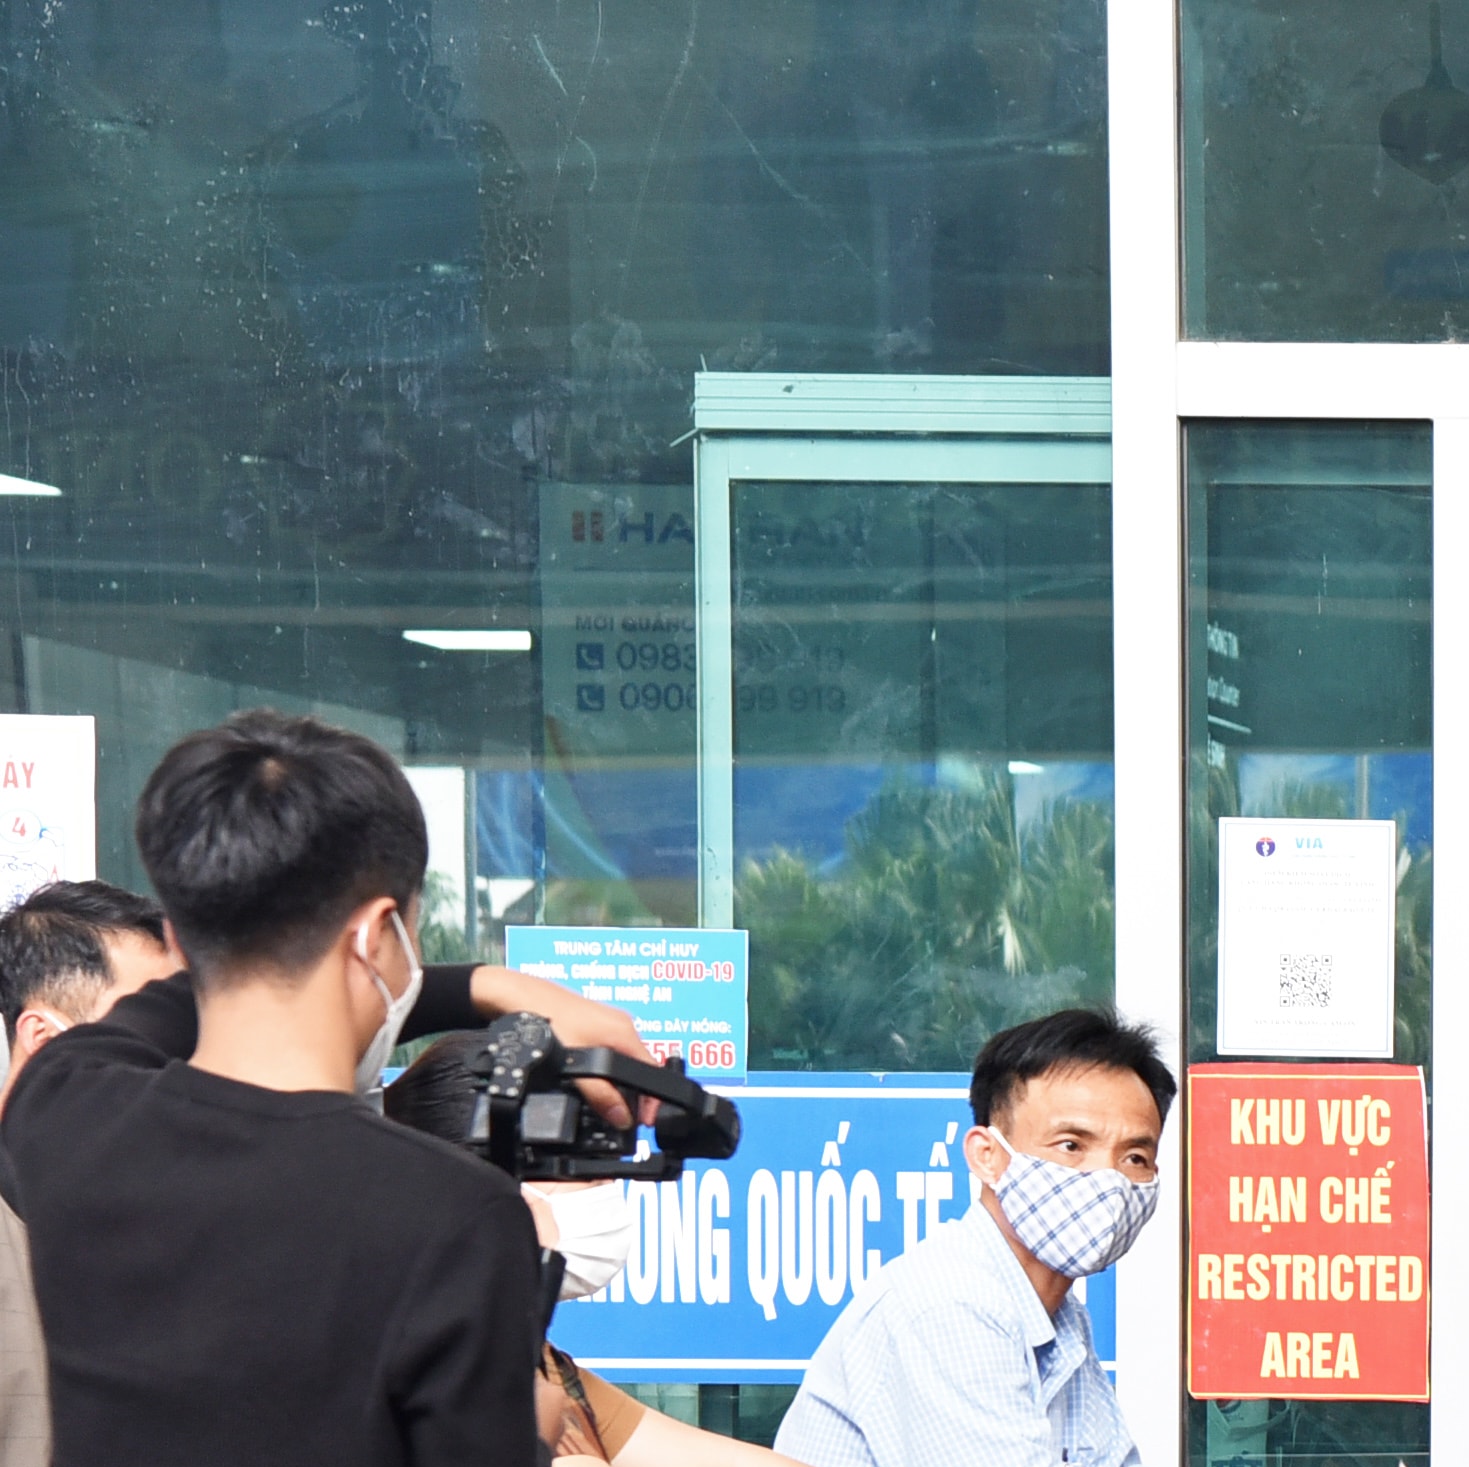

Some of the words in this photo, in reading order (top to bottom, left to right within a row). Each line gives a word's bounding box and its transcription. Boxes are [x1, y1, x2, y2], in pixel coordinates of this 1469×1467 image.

[11, 816, 28, 838] 4
[553, 940, 602, 957] TRUNG
[604, 939, 636, 957] TÂM
[639, 938, 667, 957] CHỈ
[669, 942, 699, 958] HUY
[652, 961, 734, 982] COVID-19
[652, 986, 672, 1002] AN
[664, 1018, 689, 1033] DÂY
[689, 1041, 735, 1068] 666
[1230, 1098, 1306, 1146] KHU
[1317, 1094, 1392, 1156] VỰC
[1228, 1175, 1307, 1233] HẠN
[1319, 1160, 1396, 1224] CHẾ
[746, 1120, 882, 1321] QUỐC
[1198, 1253, 1424, 1302] RESTRICTED
[1259, 1331, 1361, 1379] AREA
